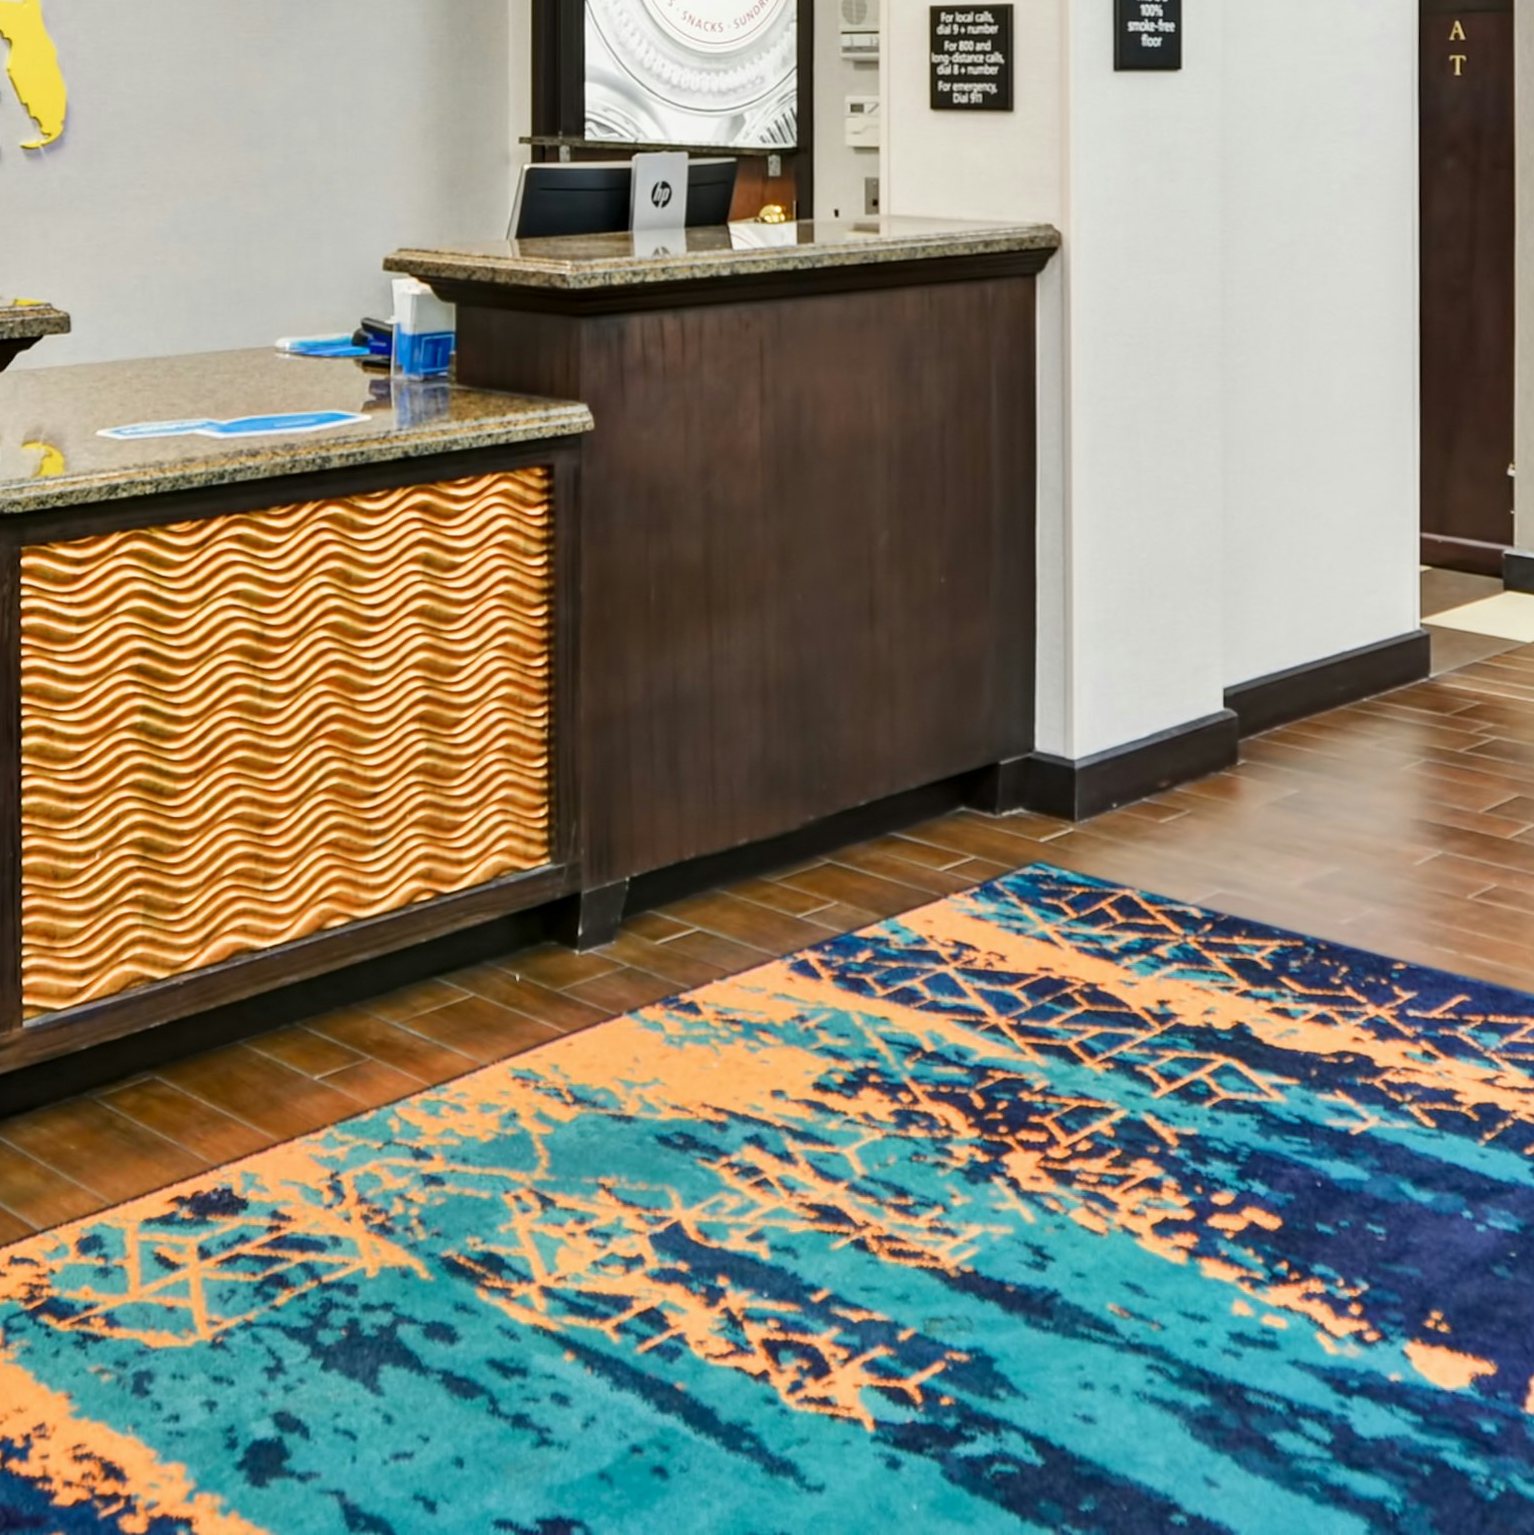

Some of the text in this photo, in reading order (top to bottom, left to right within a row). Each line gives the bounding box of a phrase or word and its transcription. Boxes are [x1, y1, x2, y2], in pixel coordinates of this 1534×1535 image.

[940, 12, 955, 24] For
[954, 10, 974, 24] local
[1139, 4, 1164, 17] 100%
[681, 10, 724, 34] SNACKS
[1127, 18, 1176, 33] smoke-free
[936, 24, 952, 35] dial
[952, 24, 959, 35] 9
[966, 23, 999, 35] number
[943, 40, 958, 52] For
[975, 39, 993, 52] and
[1140, 33, 1163, 47] floor
[936, 64, 952, 76] dial
[966, 64, 999, 75] number
[937, 80, 952, 92] For
[952, 92, 969, 104] Dial
[651, 181, 672, 208] hp
